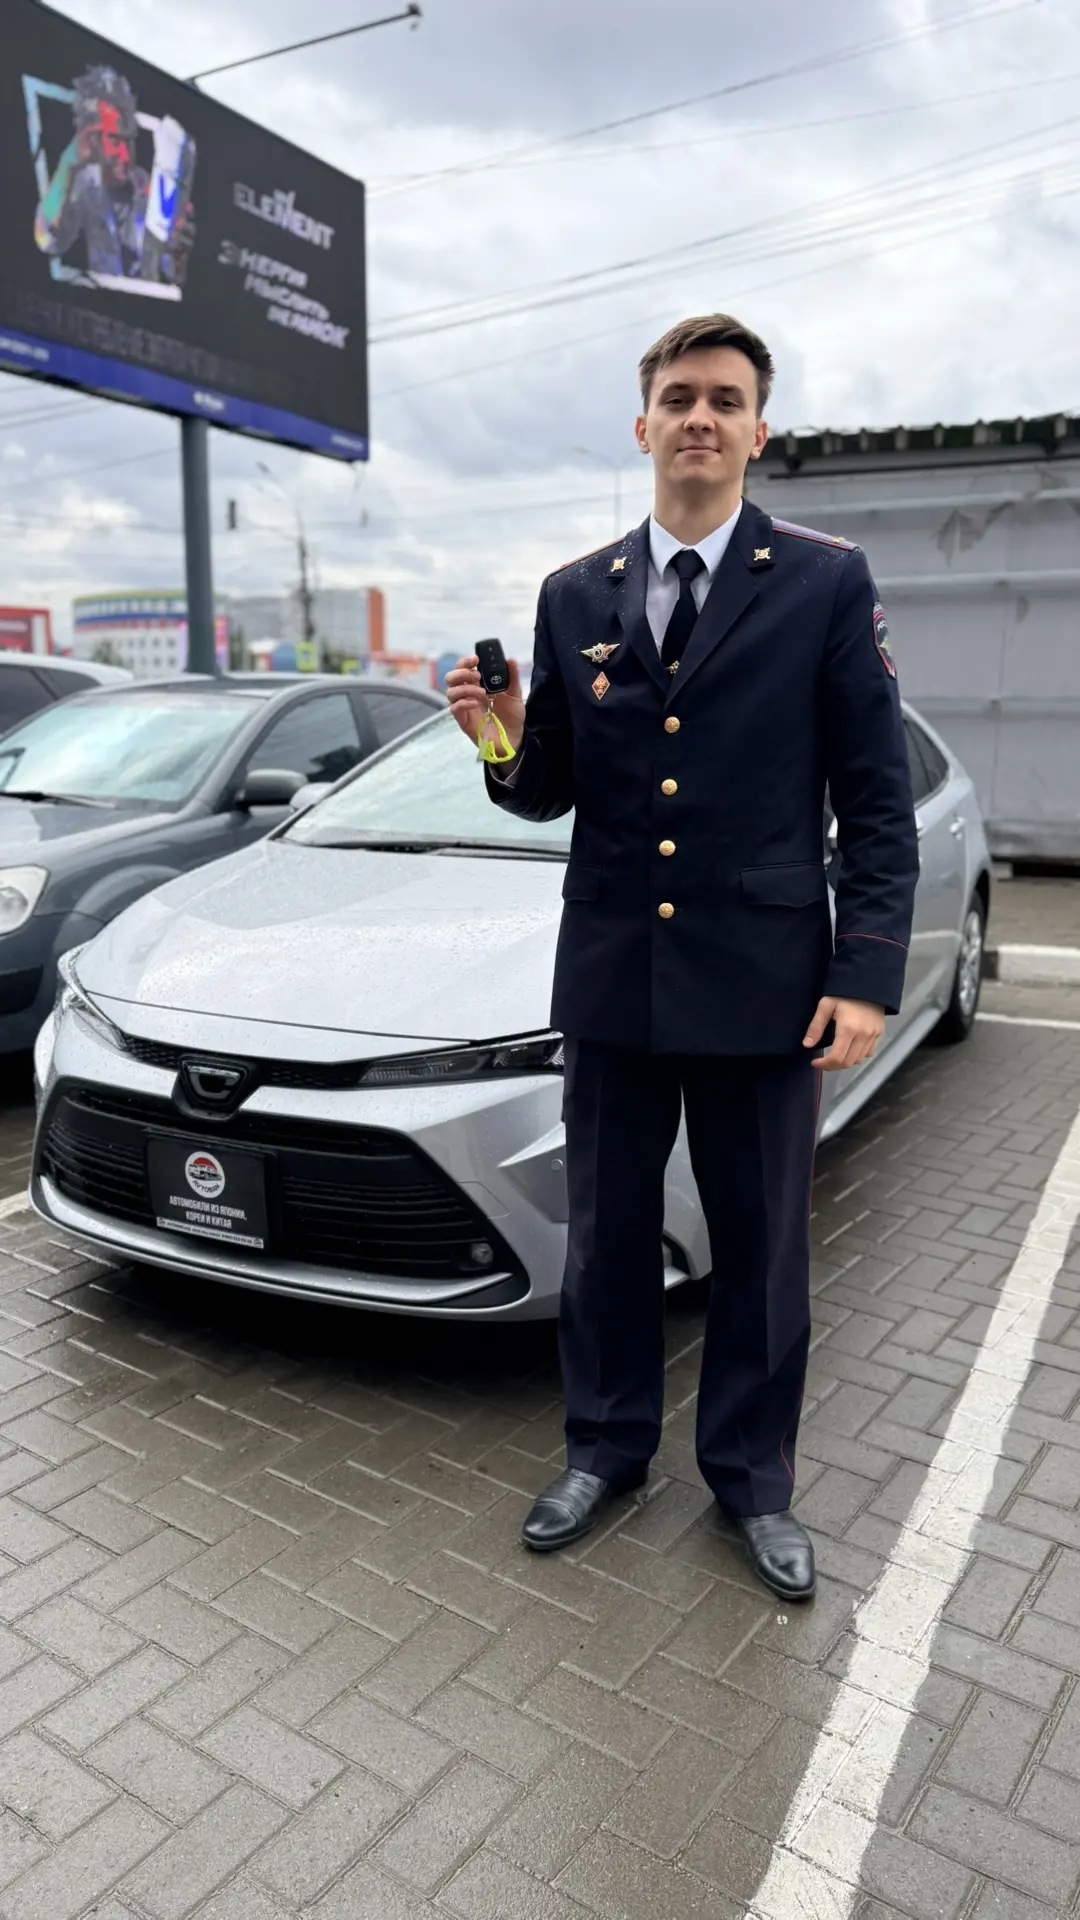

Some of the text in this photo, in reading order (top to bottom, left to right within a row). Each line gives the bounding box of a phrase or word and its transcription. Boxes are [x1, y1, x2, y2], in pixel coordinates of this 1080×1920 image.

[169, 1195, 210, 1212] АВТОМОБИЛИ
[210, 1203, 219, 1214] ИЗ
[185, 1210, 232, 1229] КОРЕИ И КИТАЯ
